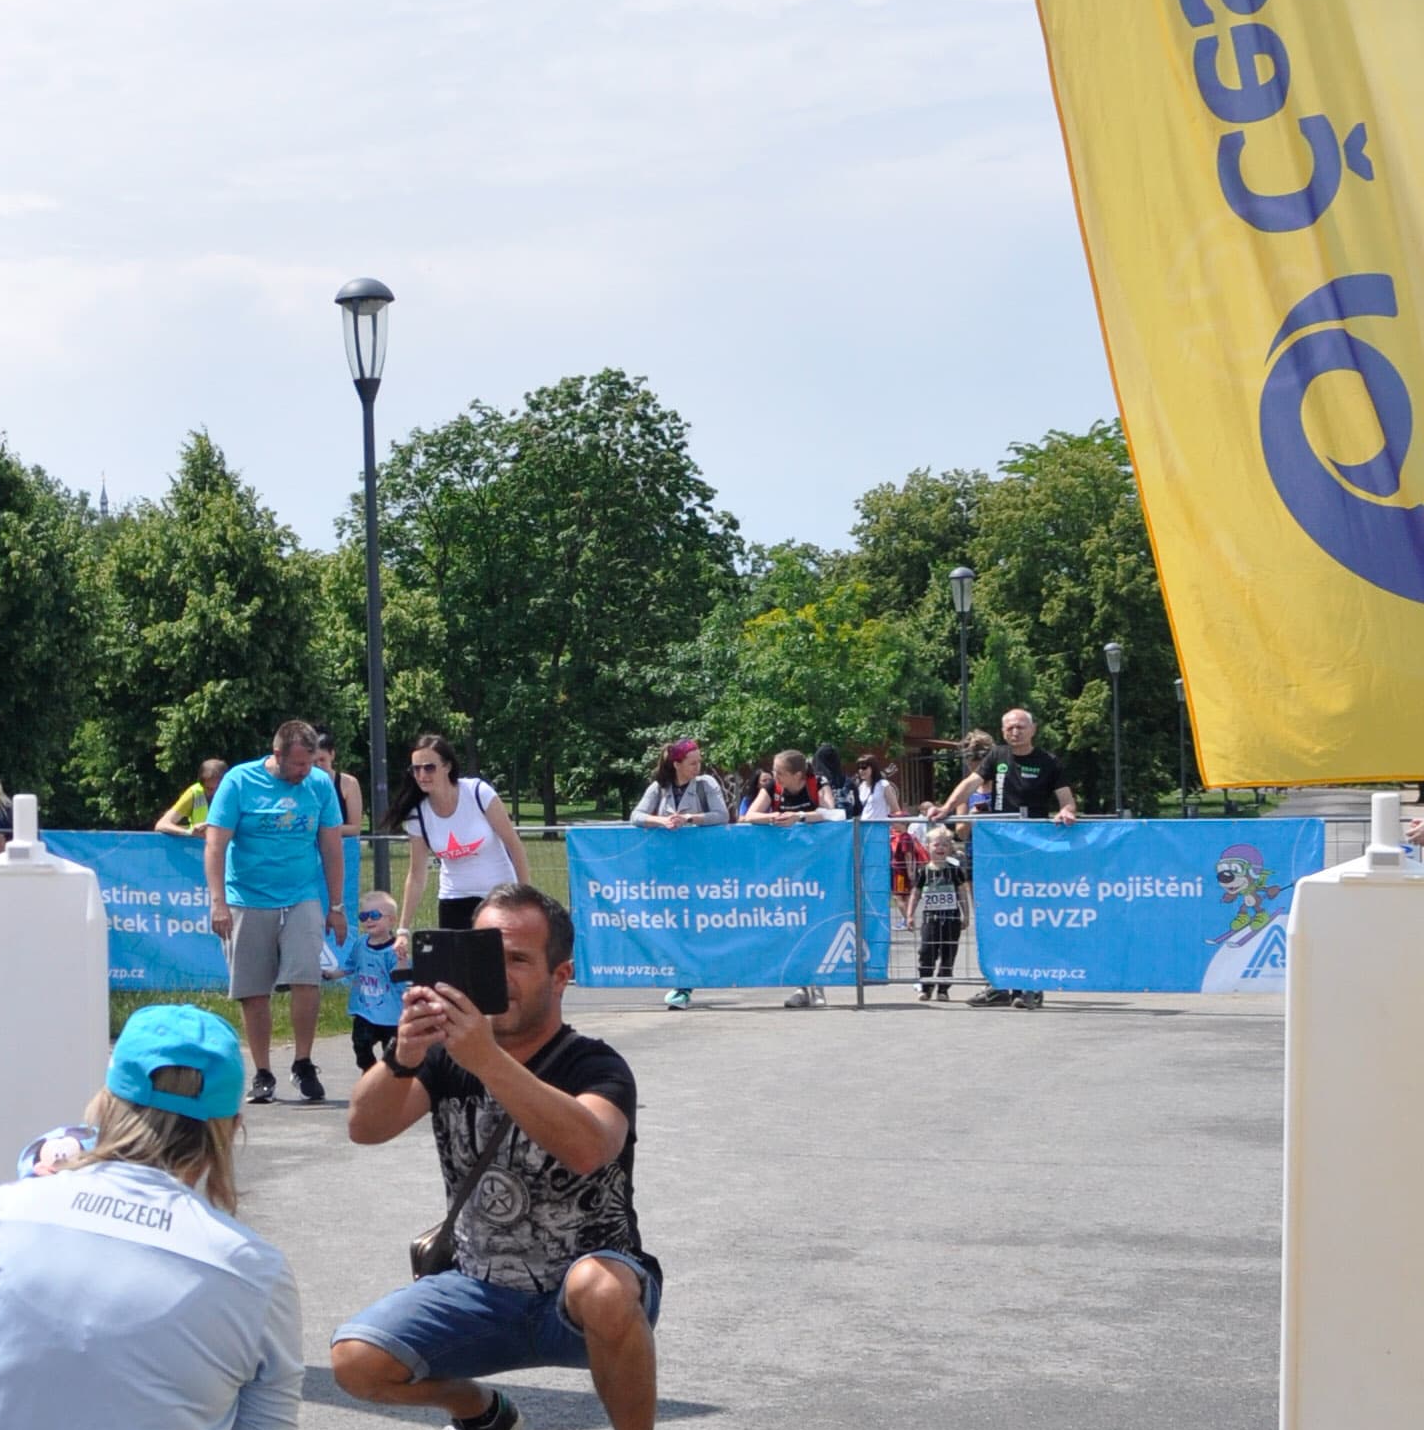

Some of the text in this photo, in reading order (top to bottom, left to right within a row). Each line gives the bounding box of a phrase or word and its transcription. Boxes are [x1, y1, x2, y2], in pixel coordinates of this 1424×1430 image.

[102, 885, 210, 907] stíme vaši
[587, 877, 826, 904] Pojistíme vaši rodinu,
[993, 872, 1204, 902] Úrazové pojištění
[155, 914, 161, 933] i
[167, 915, 213, 937] pod
[590, 906, 808, 933] majetek i podnikání
[993, 908, 1097, 928] od PVZP
[591, 963, 675, 978] www.pvzp.cz
[993, 963, 1087, 980] www.pvzp.cz
[71, 1191, 173, 1232] RUNCZECH
